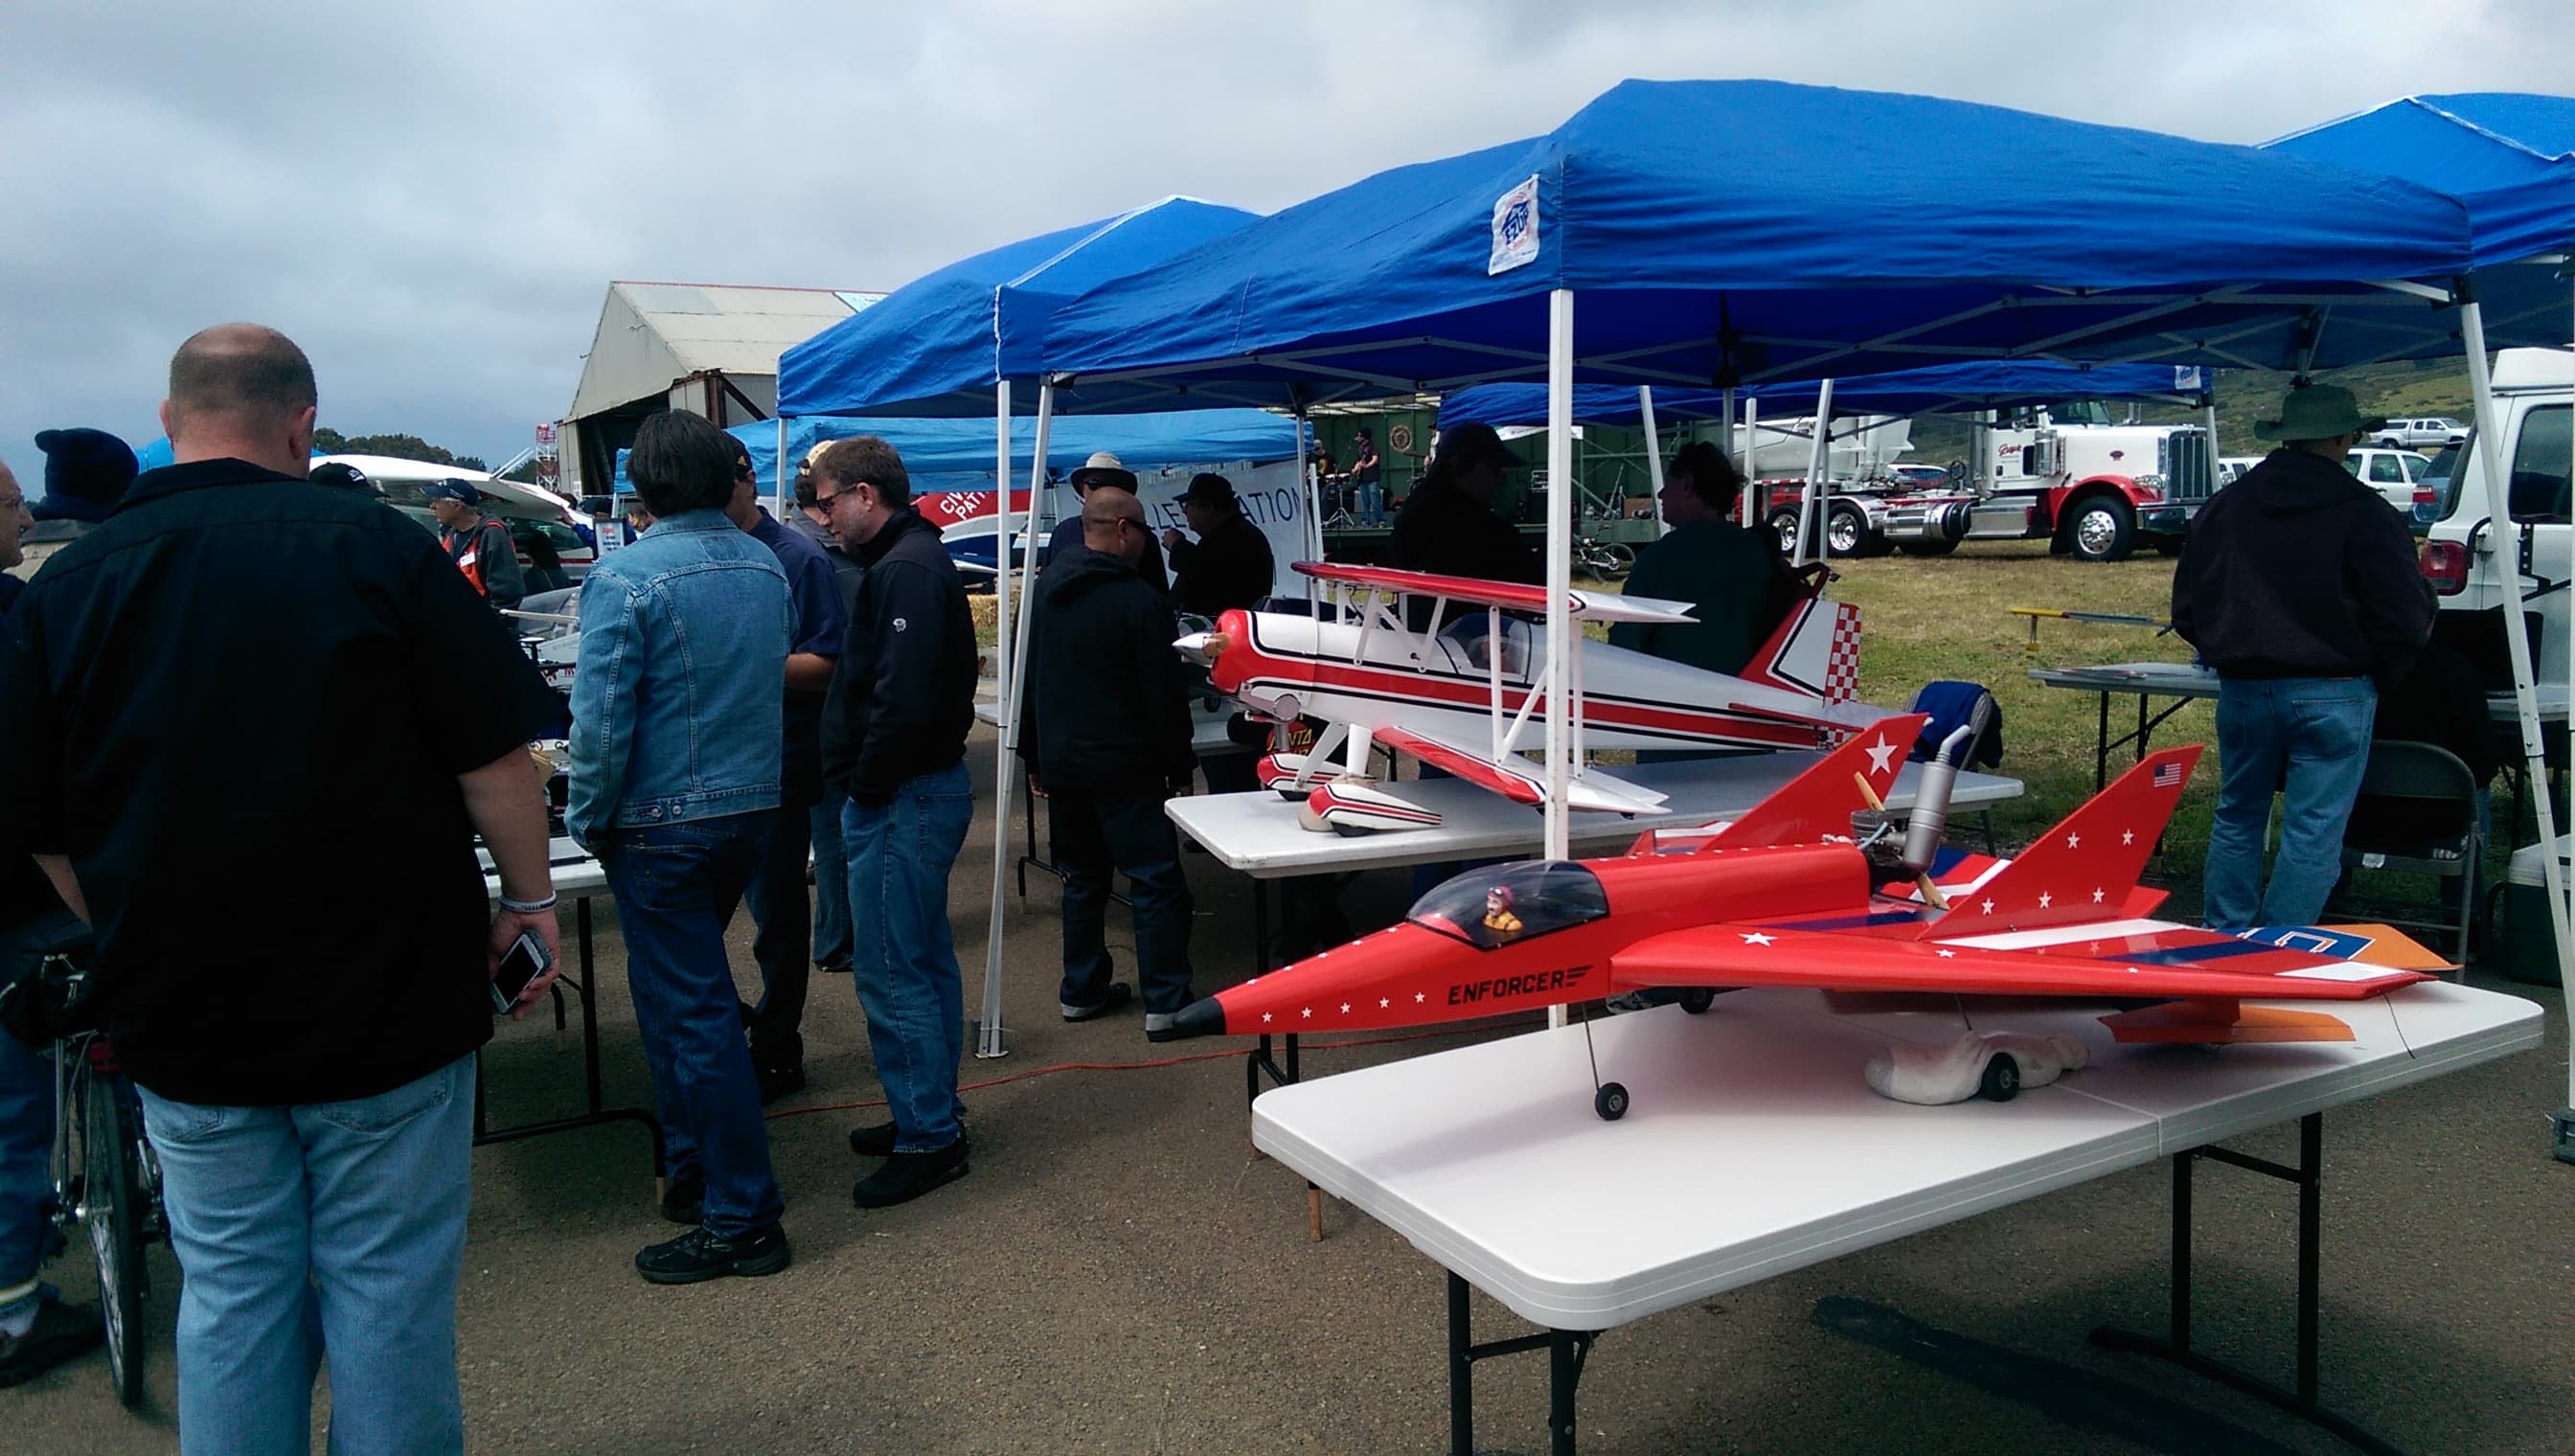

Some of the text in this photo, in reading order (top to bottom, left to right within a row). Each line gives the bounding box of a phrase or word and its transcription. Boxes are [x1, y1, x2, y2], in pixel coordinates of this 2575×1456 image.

[940, 491, 968, 514] CIV
[954, 491, 990, 520] PAT
[1447, 970, 1564, 1006] ENFORCER
